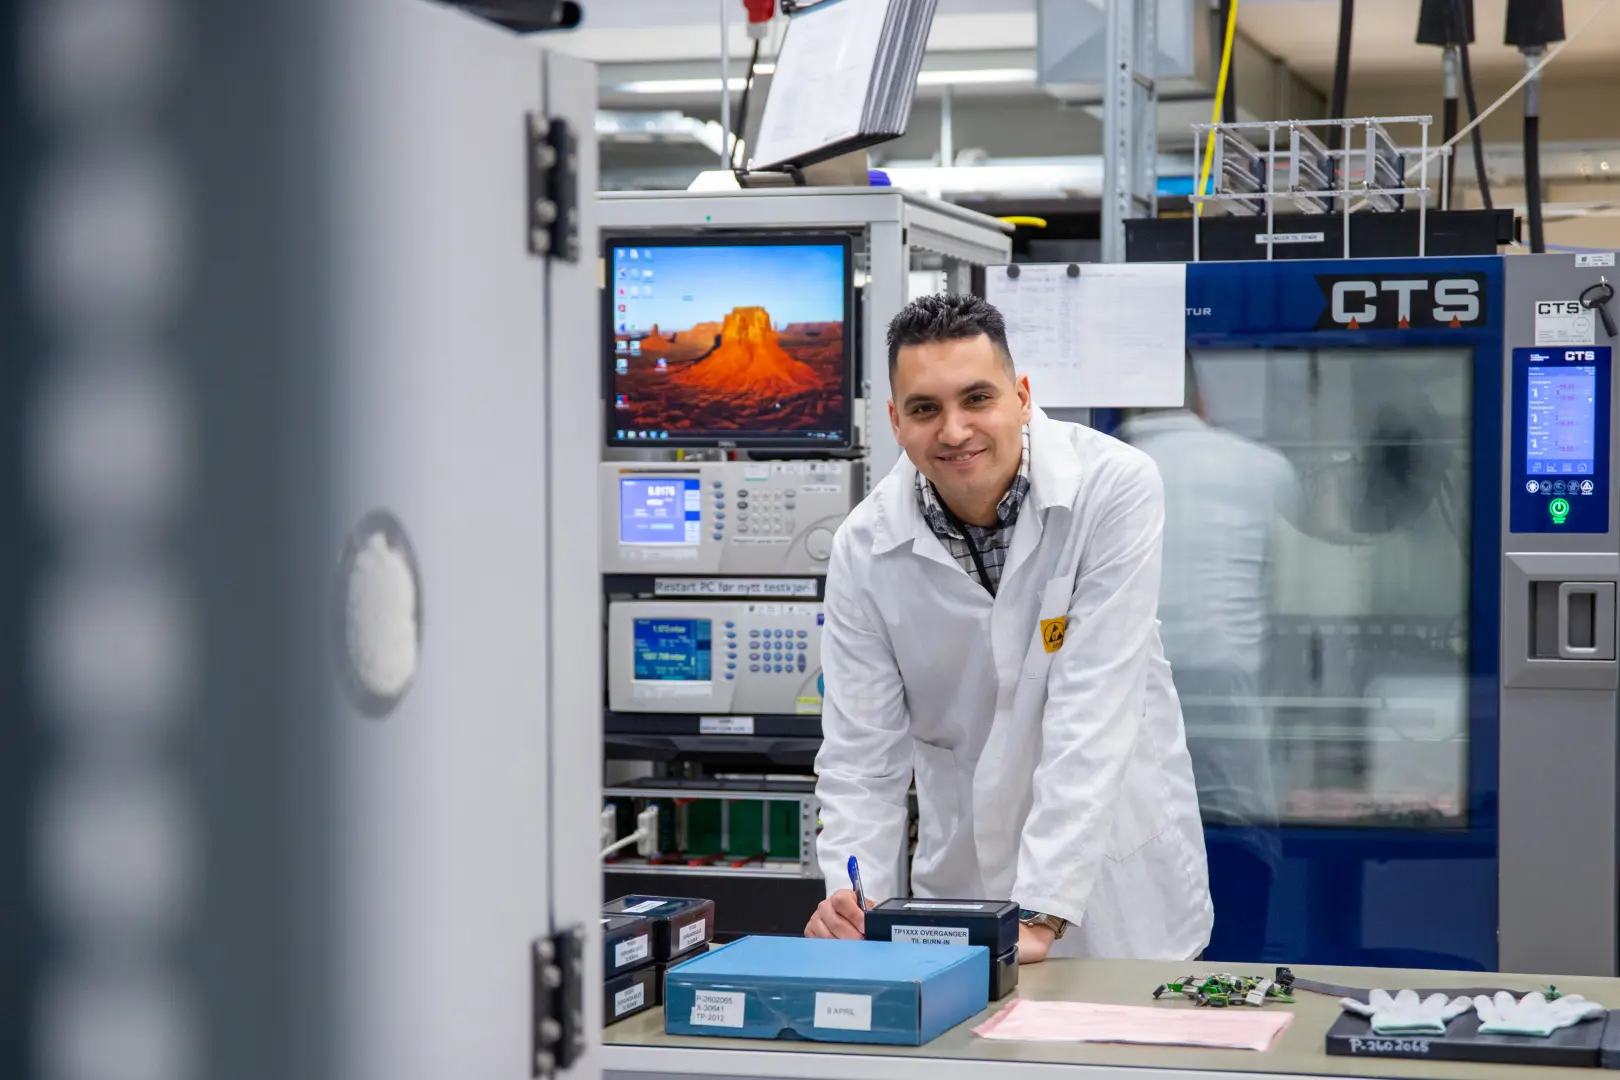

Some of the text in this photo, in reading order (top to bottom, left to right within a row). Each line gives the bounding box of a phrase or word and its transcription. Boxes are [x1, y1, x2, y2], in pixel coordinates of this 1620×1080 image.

[1332, 279, 1480, 324] CTS
[1538, 302, 1580, 315] CTS
[1565, 350, 1595, 361] CTS
[655, 581, 696, 592] Restart
[700, 581, 715, 592] PC
[737, 582, 760, 596] nytt
[893, 928, 968, 938] TP1XXX OVERGANGER
[696, 995, 733, 1005] P-2602065
[696, 1005, 725, 1013] X-30641
[833, 1008, 856, 1017] APRIL
[696, 1013, 725, 1022] TP-2012
[1349, 1038, 1430, 1053] P-2602065
